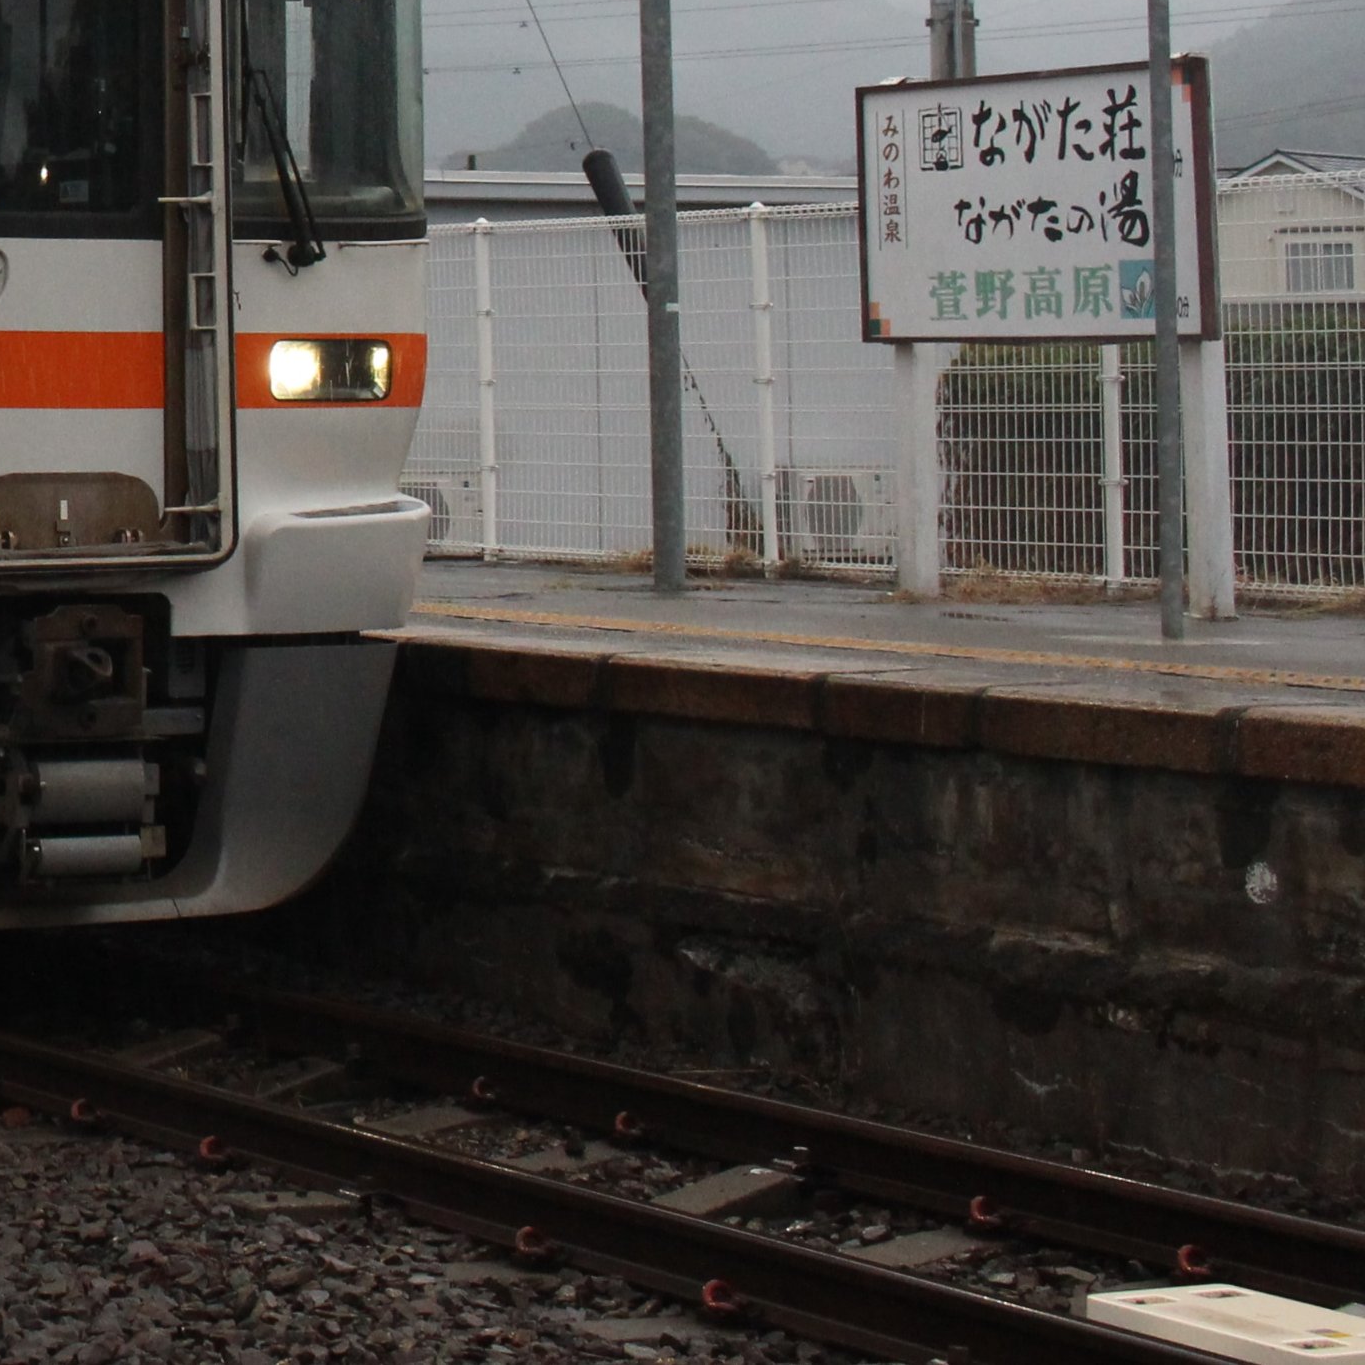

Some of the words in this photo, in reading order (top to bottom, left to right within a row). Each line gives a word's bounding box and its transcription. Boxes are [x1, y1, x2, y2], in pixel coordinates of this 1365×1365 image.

[972, 84, 1146, 166] ながた荘
[881, 115, 902, 244] みのわ温泉
[954, 170, 1151, 248] ながたの湯
